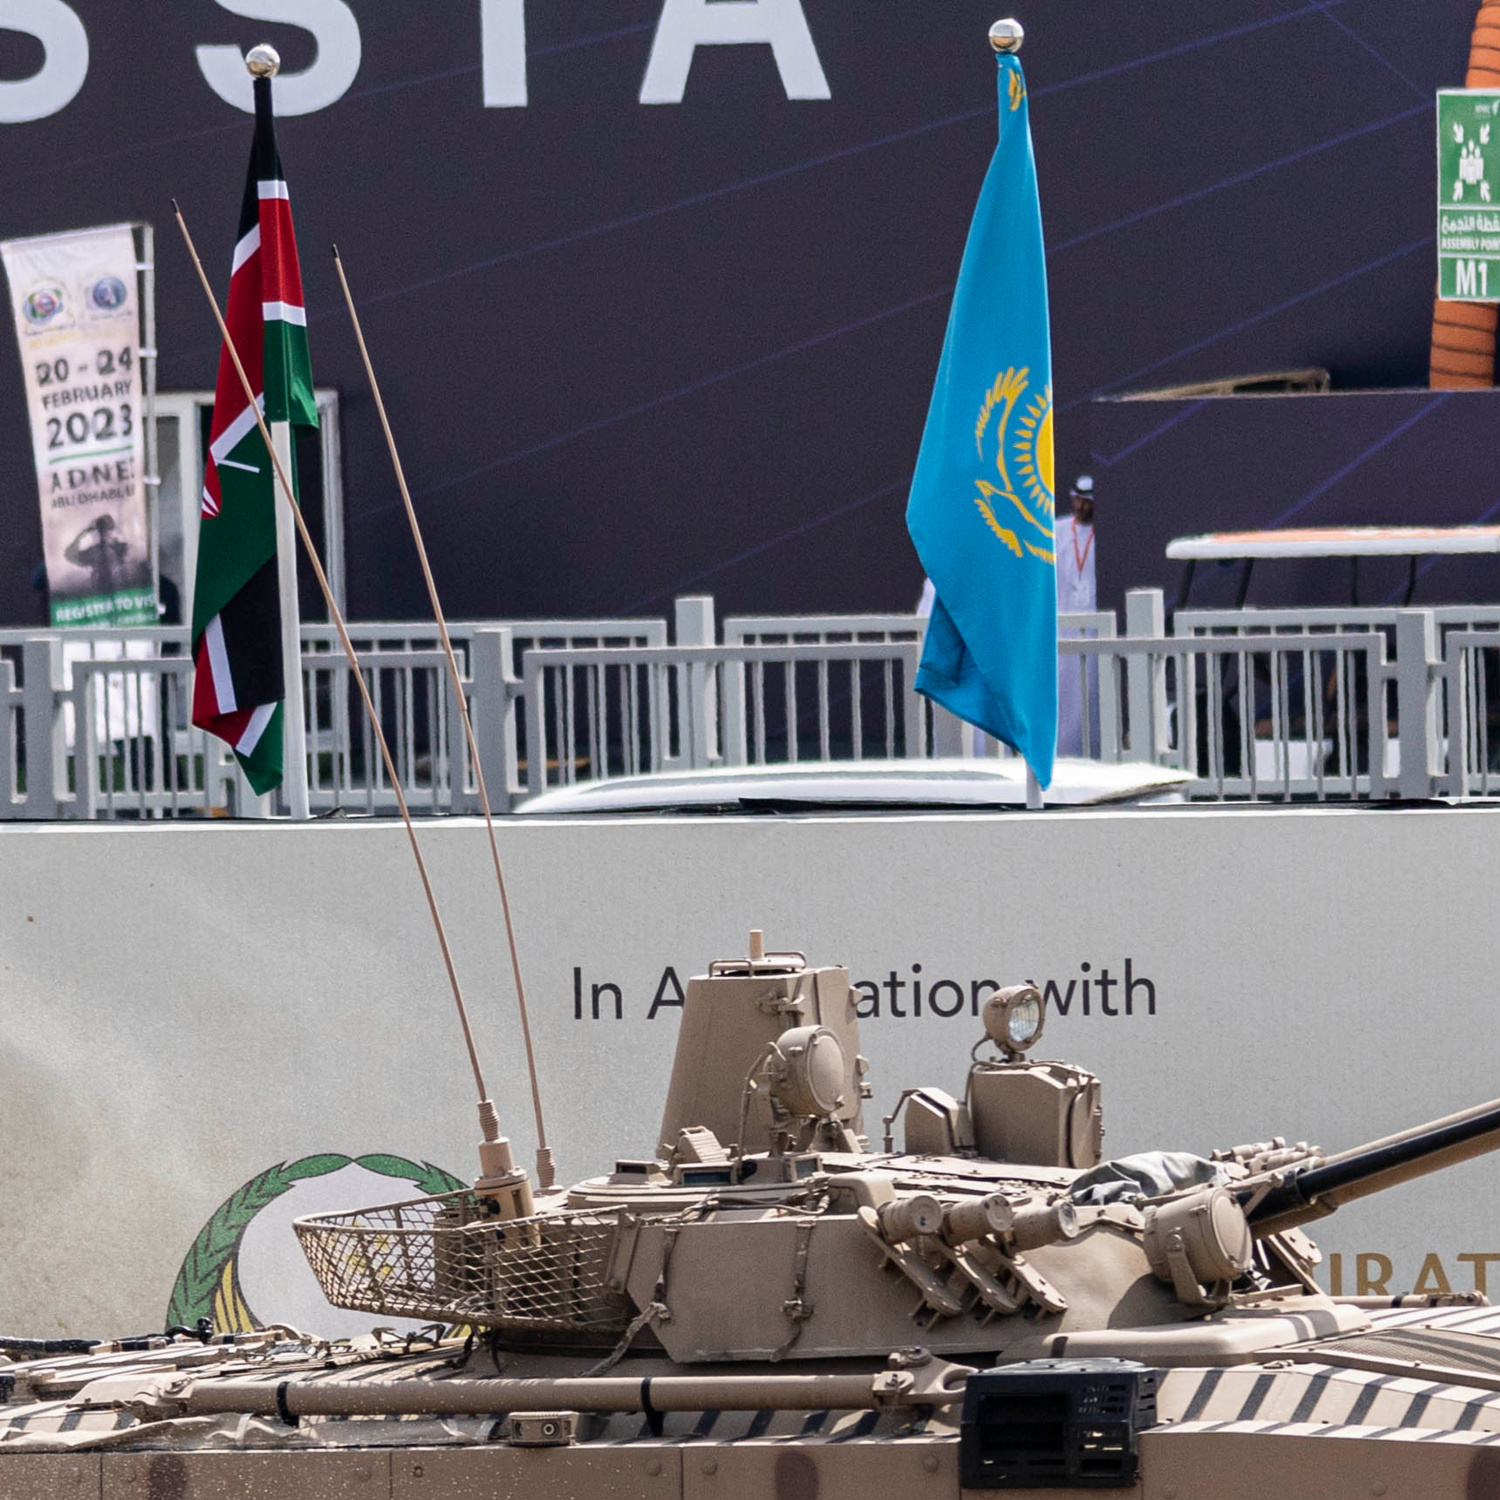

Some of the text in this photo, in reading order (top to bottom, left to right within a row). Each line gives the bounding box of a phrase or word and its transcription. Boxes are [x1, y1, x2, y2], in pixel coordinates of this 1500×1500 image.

[1456, 259, 1487, 297] M1
[36, 358, 70, 387] 20
[97, 346, 133, 376] 24
[42, 380, 132, 411] FEBRUARY
[46, 404, 134, 448] 2023
[114, 595, 133, 611] TO
[573, 957, 1157, 1020] In Aation with
